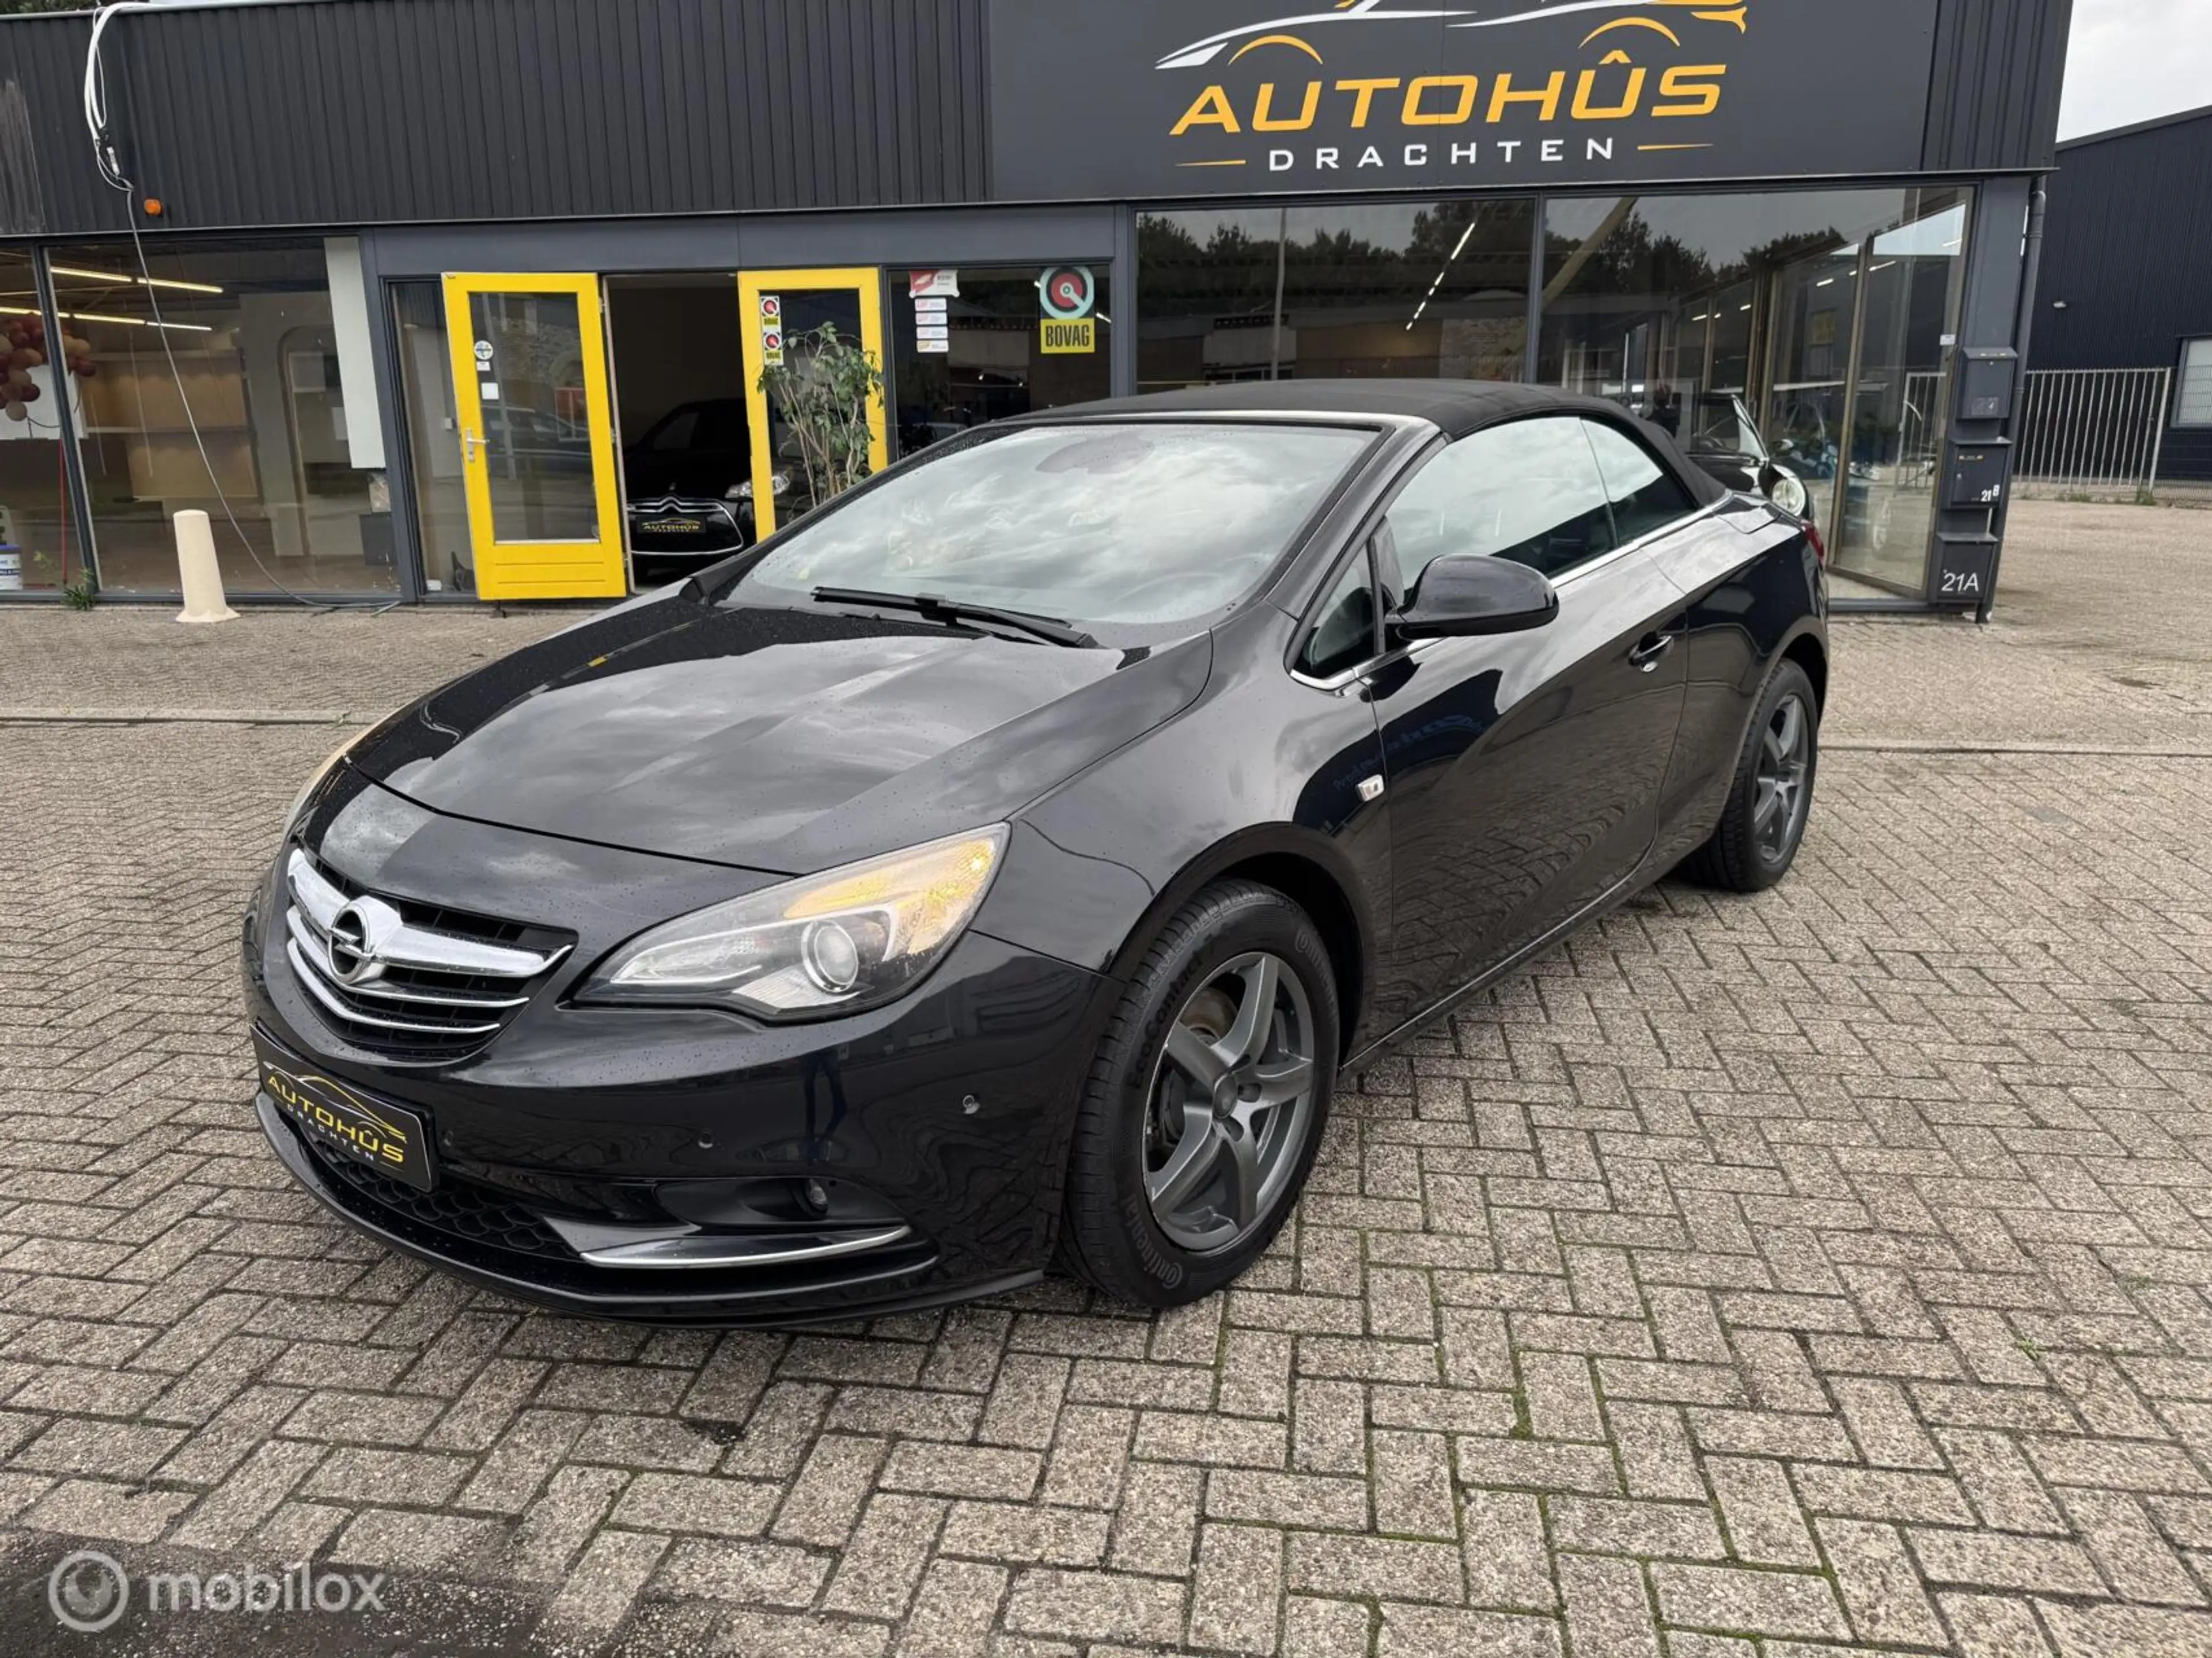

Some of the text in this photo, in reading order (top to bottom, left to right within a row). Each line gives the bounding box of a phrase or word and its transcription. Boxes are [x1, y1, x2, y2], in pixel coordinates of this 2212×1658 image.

[1170, 49, 1728, 136] AUTOHÛS
[1268, 137, 1613, 172] DRACHTEN
[1045, 325, 1090, 347] BOVAG
[1941, 569, 1979, 592] 21A
[268, 1075, 404, 1163] AUTOHÛS
[286, 1103, 375, 1162] DRACHTEN
